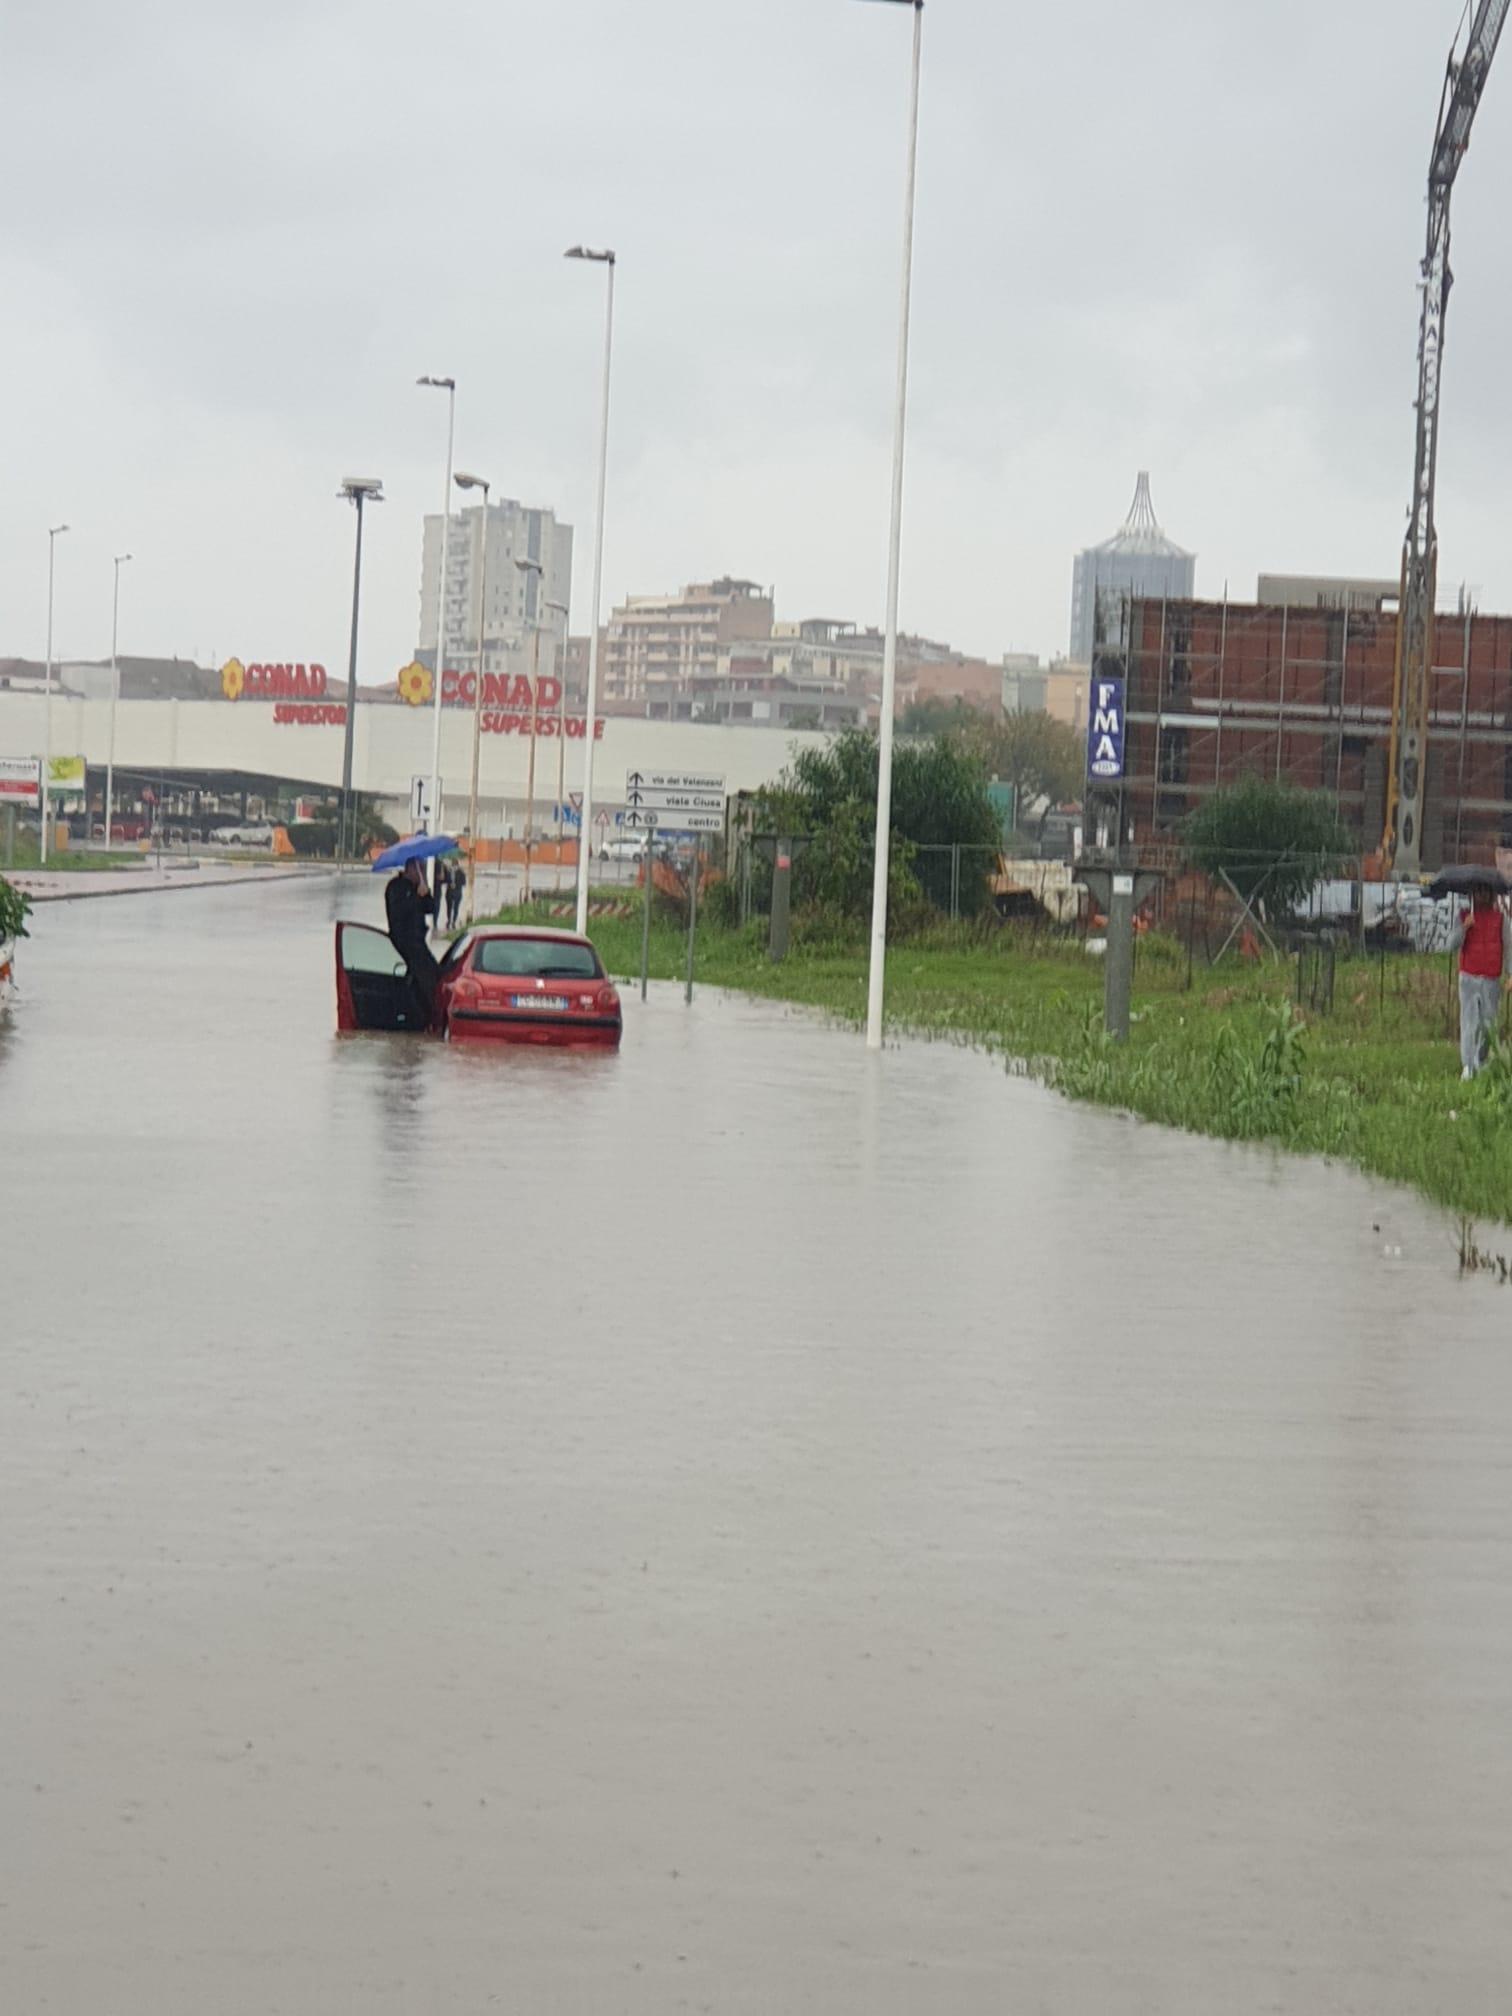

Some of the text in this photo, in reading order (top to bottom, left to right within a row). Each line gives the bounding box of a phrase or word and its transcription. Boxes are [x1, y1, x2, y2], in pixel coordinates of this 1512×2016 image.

[245, 663, 327, 696] CONAD
[440, 669, 562, 707] CONAD
[666, 796, 690, 806] viale
[688, 817, 720, 828] centro
